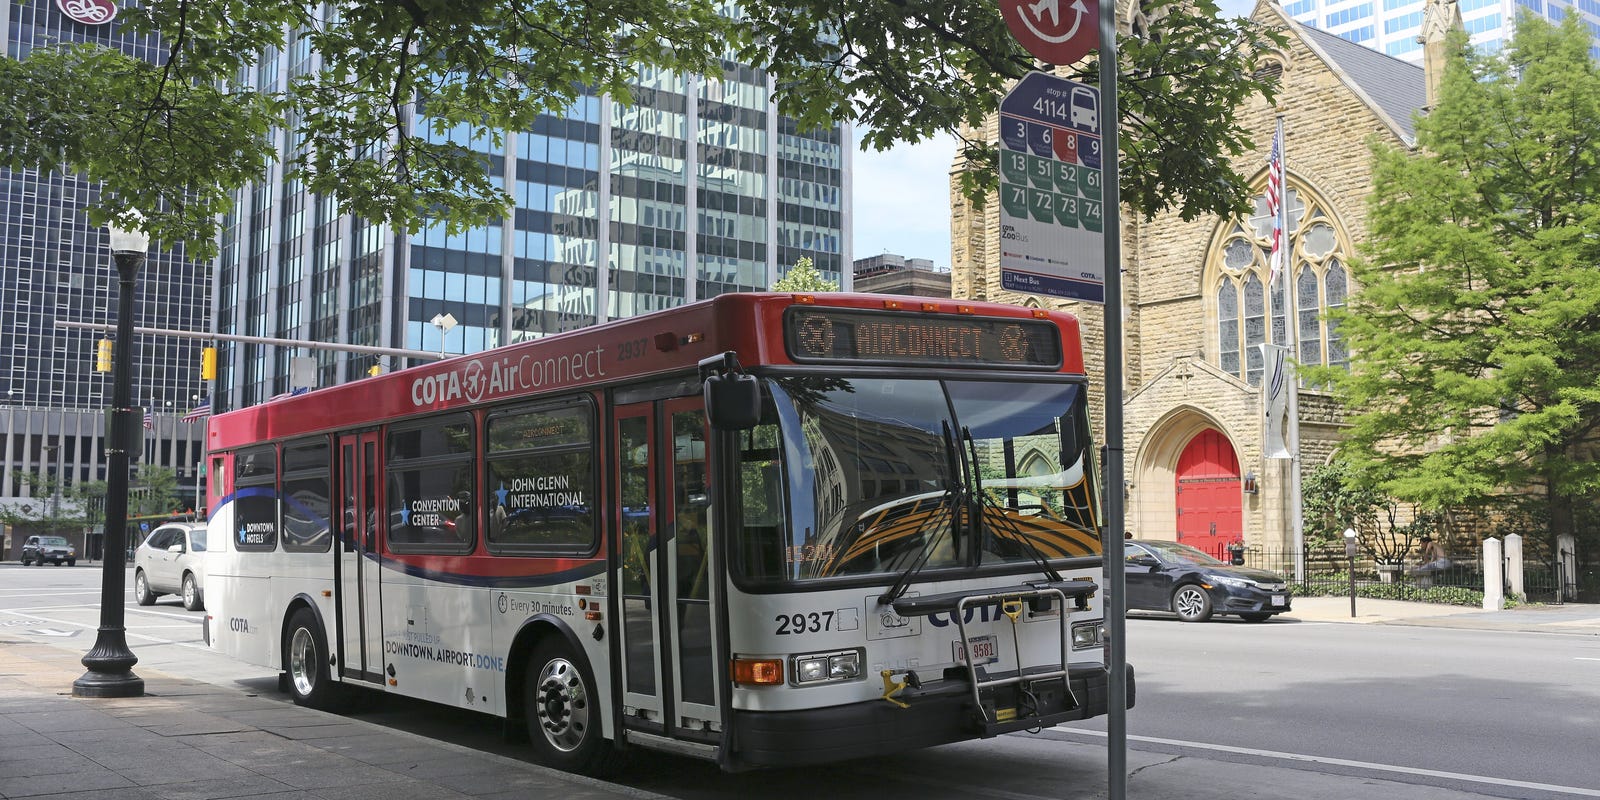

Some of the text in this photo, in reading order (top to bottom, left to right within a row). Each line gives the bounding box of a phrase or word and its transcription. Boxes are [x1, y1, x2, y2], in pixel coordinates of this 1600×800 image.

[1046, 87, 1060, 98] stop
[1033, 97, 1068, 120] 4114
[1017, 122, 1025, 138] 3
[1042, 129, 1050, 144] 6
[1068, 134, 1075, 150] 8
[1092, 140, 1099, 155] 9
[1011, 154, 1026, 170] 13
[1038, 160, 1051, 176] 51
[1060, 166, 1076, 182] 52
[1088, 172, 1100, 187] 61
[1012, 188, 1100, 219] 71 72 73 74
[1014, 274, 1040, 285] Next Bus
[857, 322, 982, 358] AIRCONNECT
[617, 338, 648, 361] 2937
[412, 344, 606, 406] COTA AirConnect
[510, 475, 569, 492] JOHN GLENN
[412, 498, 460, 512] CONVENTION
[510, 491, 584, 508] INTERNATIONAL
[246, 522, 274, 533] DOWNTOWN
[412, 514, 439, 526] CENTER
[246, 534, 264, 544] HOTELS
[511, 599, 574, 616] Every 30 minutes.
[775, 610, 834, 635] 2937
[386, 640, 435, 661] DOWNTOWN.
[436, 652, 475, 668] AIRPORT.
[974, 642, 994, 658] 9581
